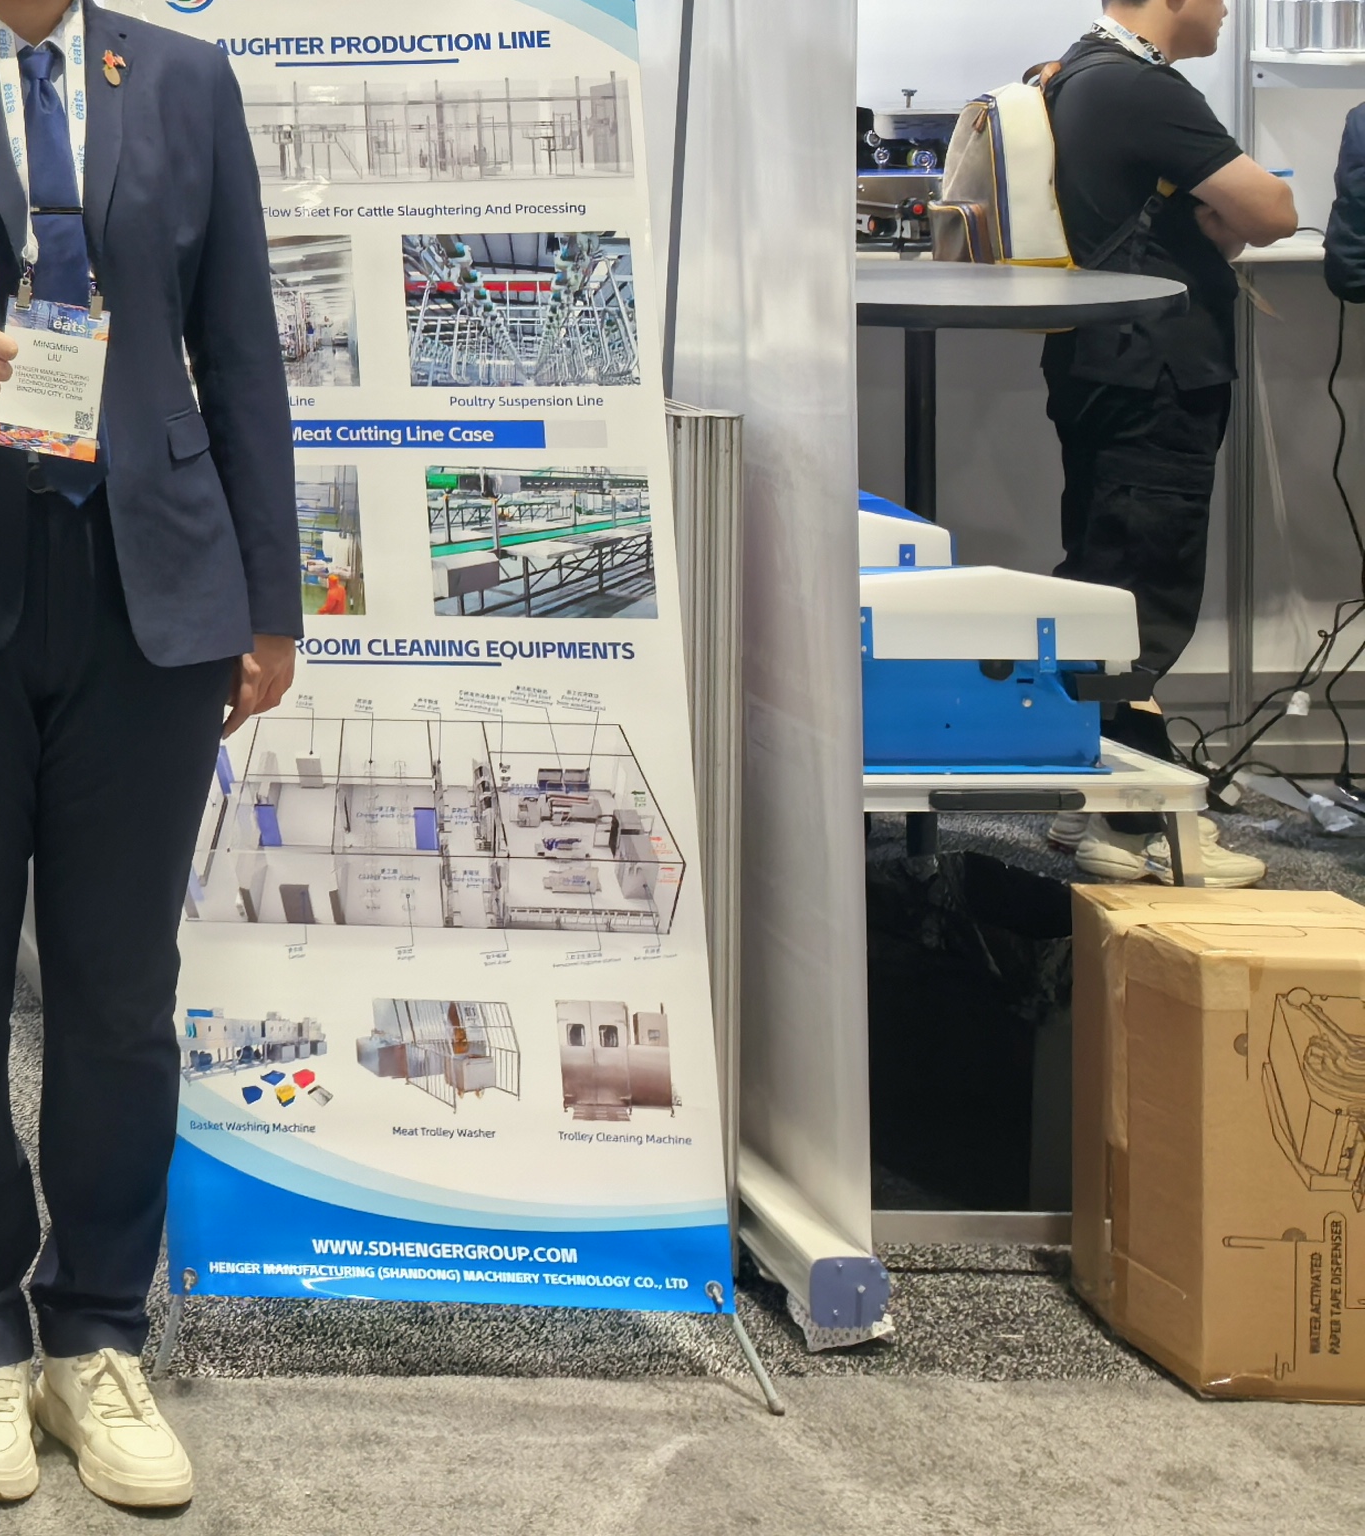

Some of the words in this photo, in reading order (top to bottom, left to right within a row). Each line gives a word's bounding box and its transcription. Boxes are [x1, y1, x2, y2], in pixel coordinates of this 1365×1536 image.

[73, 34, 82, 65] eats
[213, 33, 325, 55] AUGHTER
[330, 33, 491, 54] PRODUCTION
[498, 30, 551, 49] LINE
[4, 83, 15, 114] eats
[74, 90, 84, 120] eats
[295, 205, 330, 218] Sheet
[334, 205, 353, 217] For
[357, 204, 394, 217] Cattle
[397, 203, 482, 219] Slaughtering
[485, 203, 512, 215] And
[515, 201, 586, 218] Processing
[53, 318, 87, 334] eats
[33, 339, 78, 354] MINGMING
[290, 395, 315, 408] Line
[449, 395, 495, 410] Poultry
[498, 395, 573, 410] Suspension
[576, 395, 604, 407] Line
[336, 425, 402, 445] Cutting
[405, 426, 444, 442] Line
[448, 426, 494, 442] Case
[367, 638, 480, 658] CLEANING
[486, 640, 635, 661] EQUIPMENTS
[190, 1120, 223, 1132] Basket
[225, 1121, 270, 1135] Washing
[272, 1122, 316, 1134] Machine
[392, 1125, 418, 1137] Meat
[420, 1127, 454, 1141] Trolley
[457, 1128, 496, 1139] Washer
[559, 1131, 593, 1145] Trolley
[596, 1132, 642, 1147] Cleaning
[646, 1135, 692, 1147] Machine
[312, 1238, 578, 1264] WWW.SDHENGERGROUP.COM
[1331, 1220, 1342, 1284] DISPENSER
[209, 1261, 261, 1275] HENGER
[263, 1263, 375, 1279] MANUFACTURING
[377, 1265, 460, 1284] (SHANDONG)
[463, 1270, 539, 1285] MACHINERY
[543, 1273, 630, 1289] TECHNOLOGY
[634, 1276, 662, 1291] CO.,
[665, 1277, 688, 1290] LTD
[1331, 1285, 1341, 1316] TAPE
[1329, 1316, 1341, 1355] PAPER
